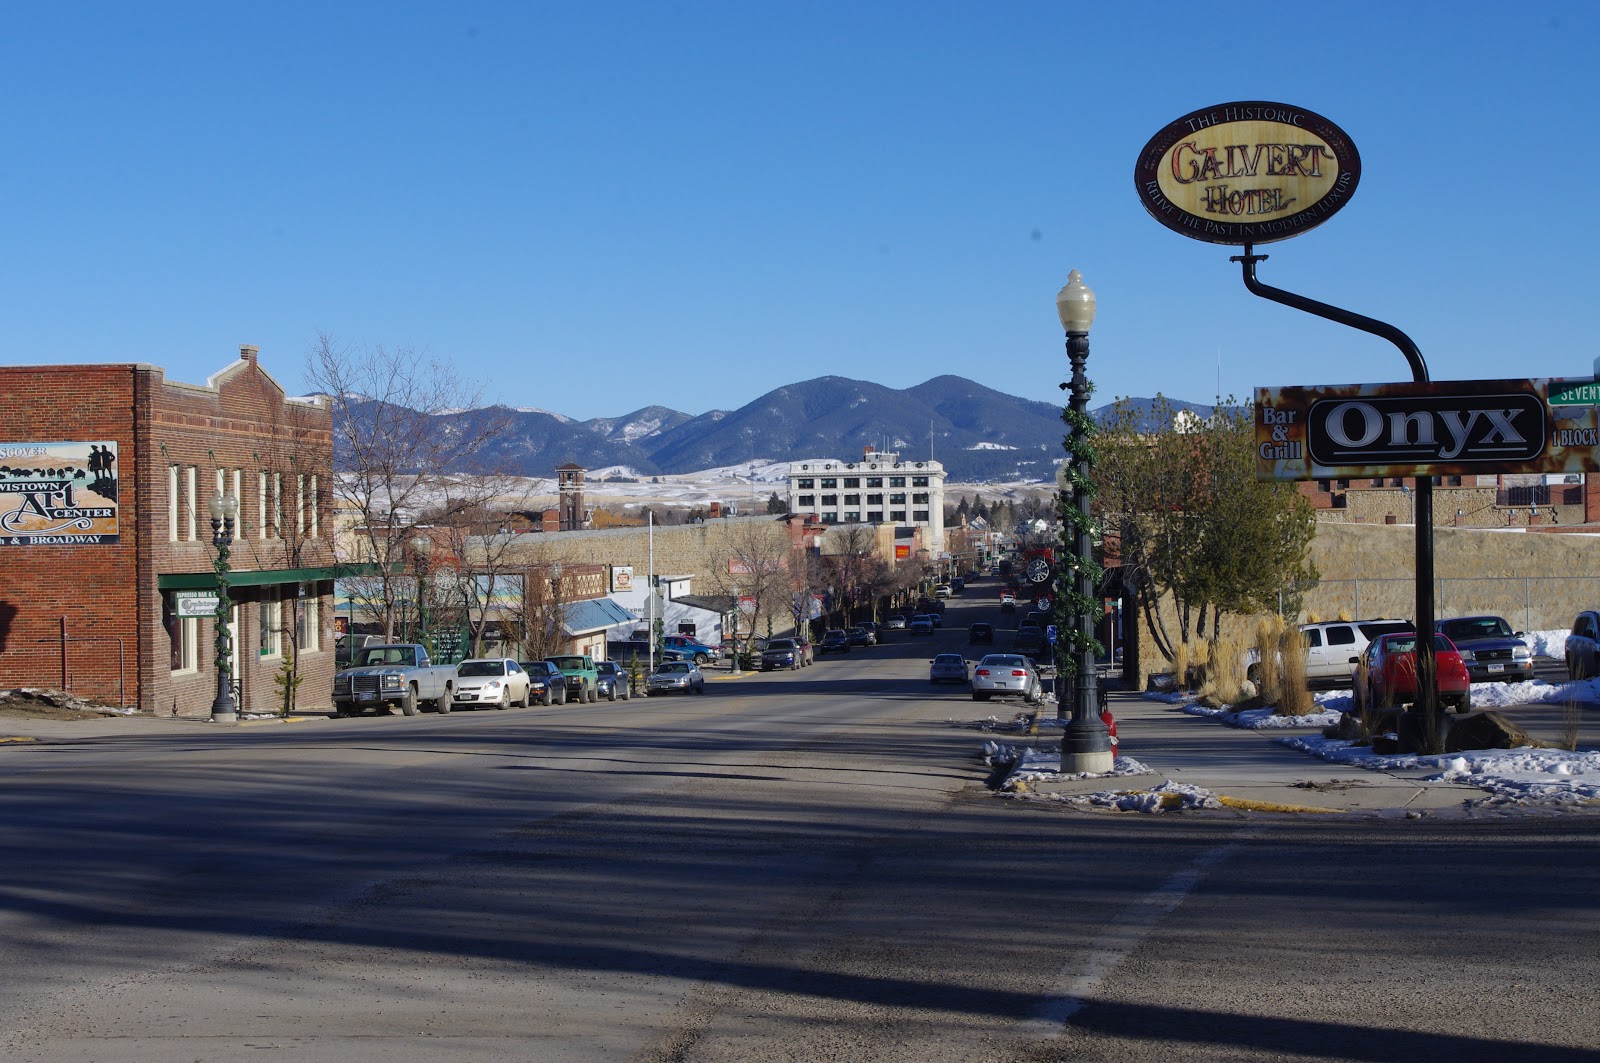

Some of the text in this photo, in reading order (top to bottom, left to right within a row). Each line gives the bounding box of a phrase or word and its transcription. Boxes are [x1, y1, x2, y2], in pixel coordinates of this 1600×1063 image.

[1185, 106, 1305, 132] THE HISTORIC
[1171, 141, 1335, 185] CALVERT
[1145, 169, 1352, 236] RELIVE THE PAST IN MODERN LUXURY
[1201, 185, 1296, 216] HOTEL
[1561, 386, 1600, 401] SEVENT
[1263, 407, 1297, 425] Bar
[1271, 423, 1288, 442] &
[1325, 401, 1528, 458] Onyx
[1552, 428, 1598, 447] 1 BLOCK
[1259, 441, 1302, 460] Grill
[1, 480, 82, 531] Art
[54, 509, 113, 518] CENTER
[10, 536, 21, 545] &
[29, 535, 102, 544] BROADWAY
